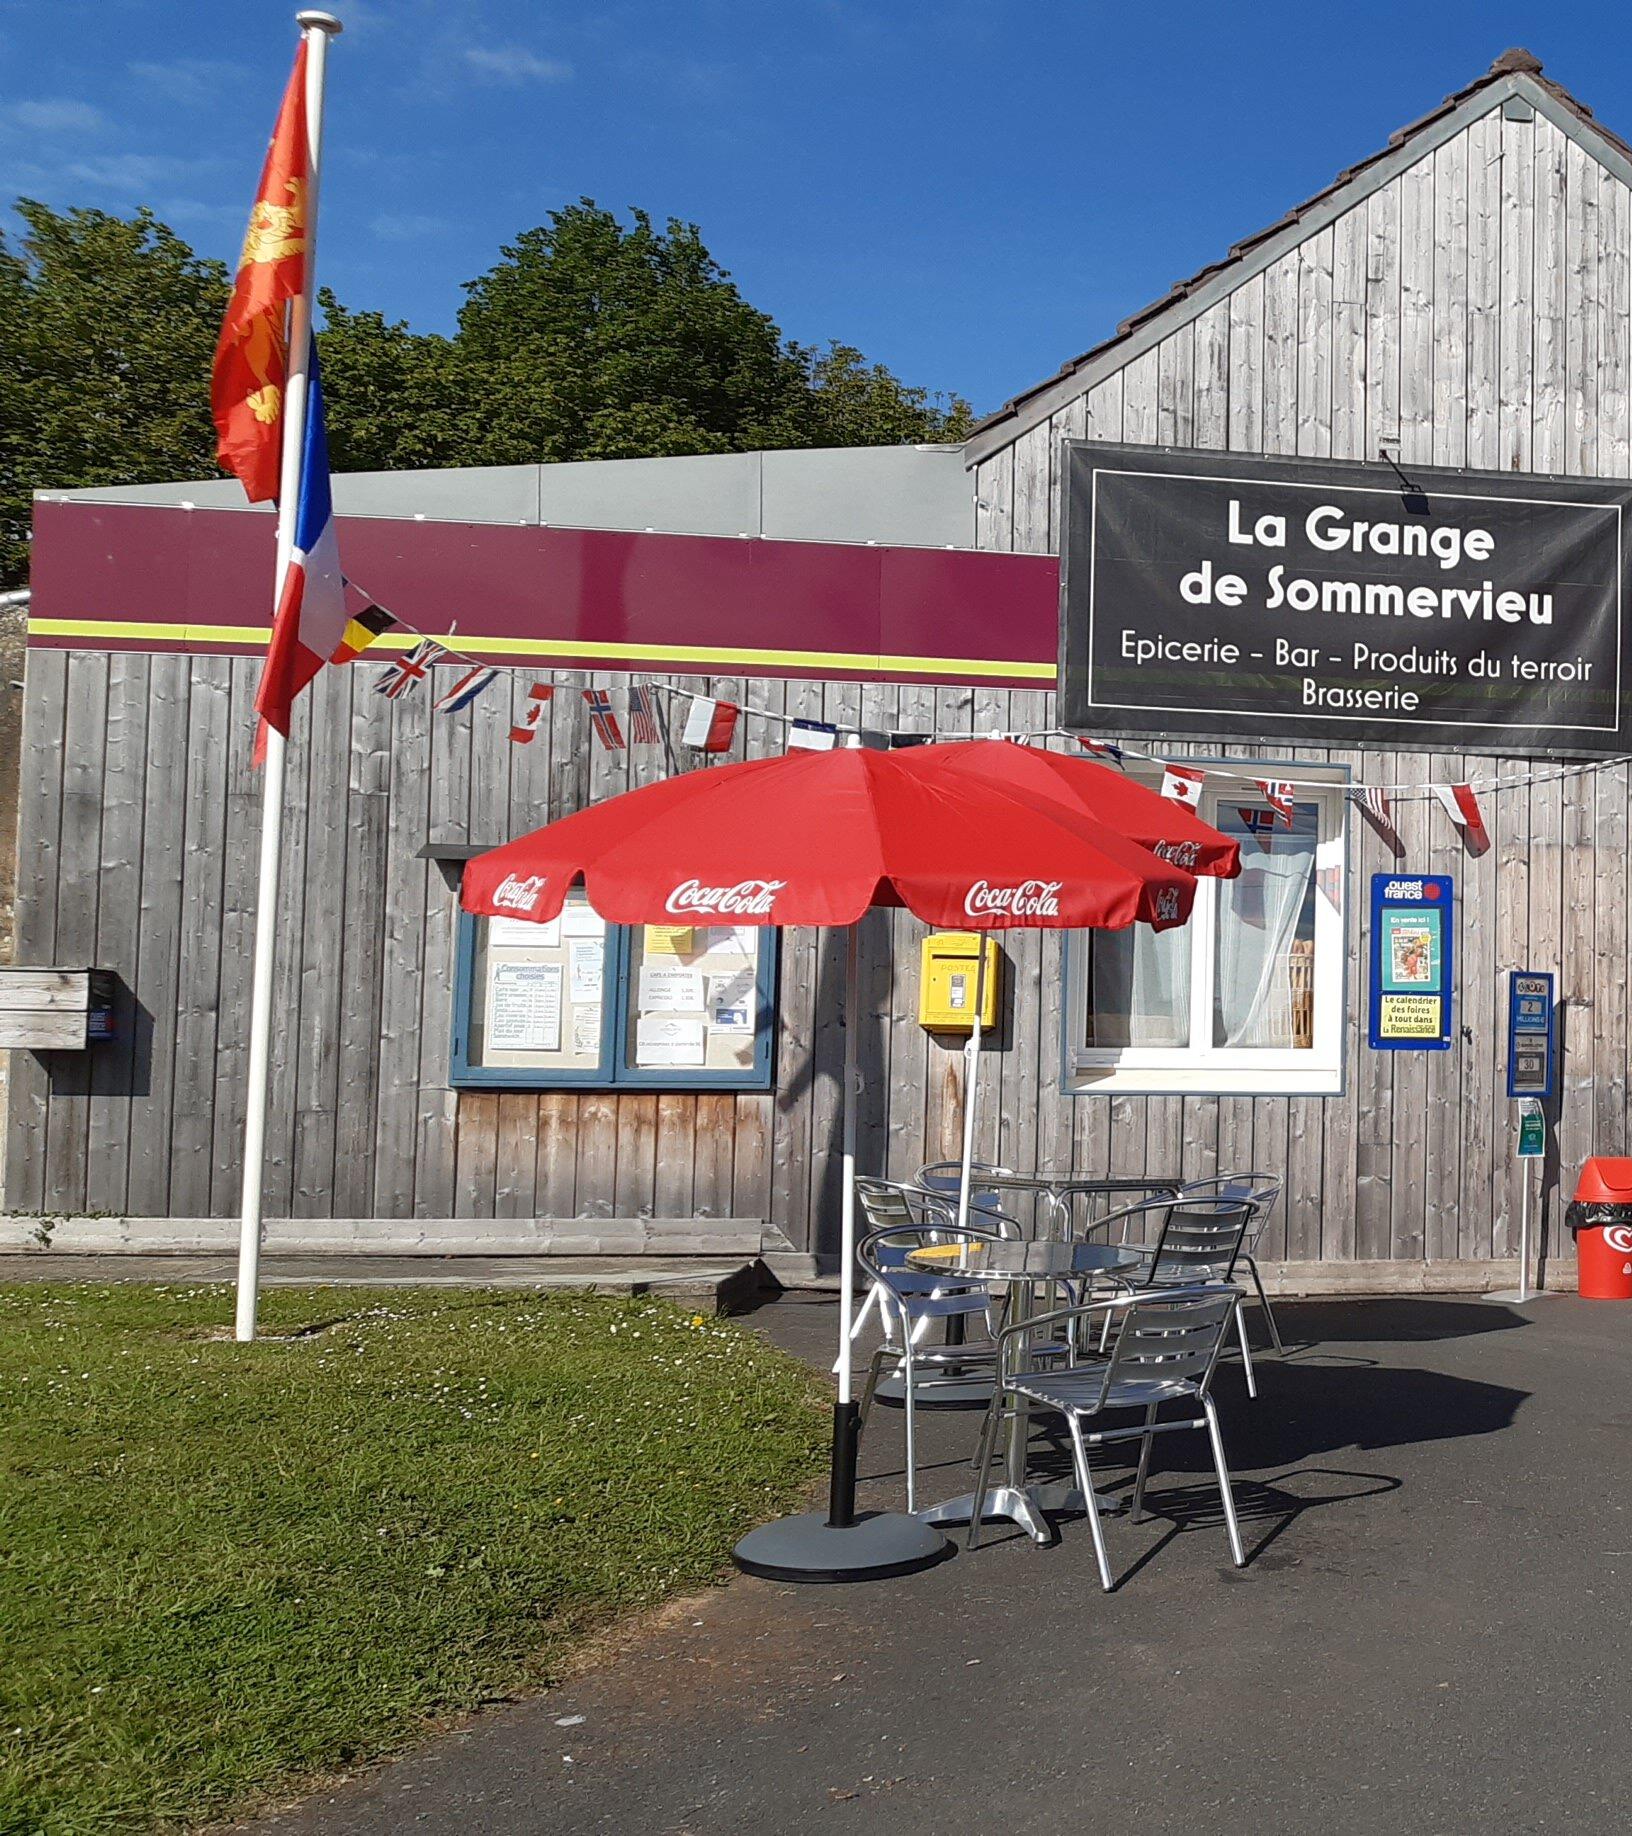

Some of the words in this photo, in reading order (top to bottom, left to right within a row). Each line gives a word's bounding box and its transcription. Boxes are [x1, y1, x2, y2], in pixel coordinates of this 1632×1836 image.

[1228, 499, 1286, 547] La
[1305, 505, 1495, 570] Grange
[1179, 560, 1248, 607] de
[1266, 564, 1553, 625] Sommervieu
[1121, 629, 1240, 665] Epicerie
[1275, 641, 1320, 668] Bar
[1353, 643, 1458, 676] Produits
[1467, 650, 1501, 678] du
[1511, 655, 1593, 681] terroir
[1303, 678, 1420, 712] Brasserie
[1384, 886, 1423, 899] france
[1389, 880, 1423, 890] ouest
[665, 879, 787, 915] Coca-Cola
[964, 880, 1063, 917] Coca-Cola
[1385, 996, 1395, 1004] Le
[1396, 996, 1438, 1005] calendrier
[1391, 1005, 1405, 1013] des
[1407, 1005, 1430, 1014] foires
[1387, 1014, 1393, 1022] à
[1394, 1015, 1412, 1023] tout
[1413, 1015, 1433, 1024] dans
[1523, 1059, 1535, 1070] 30
